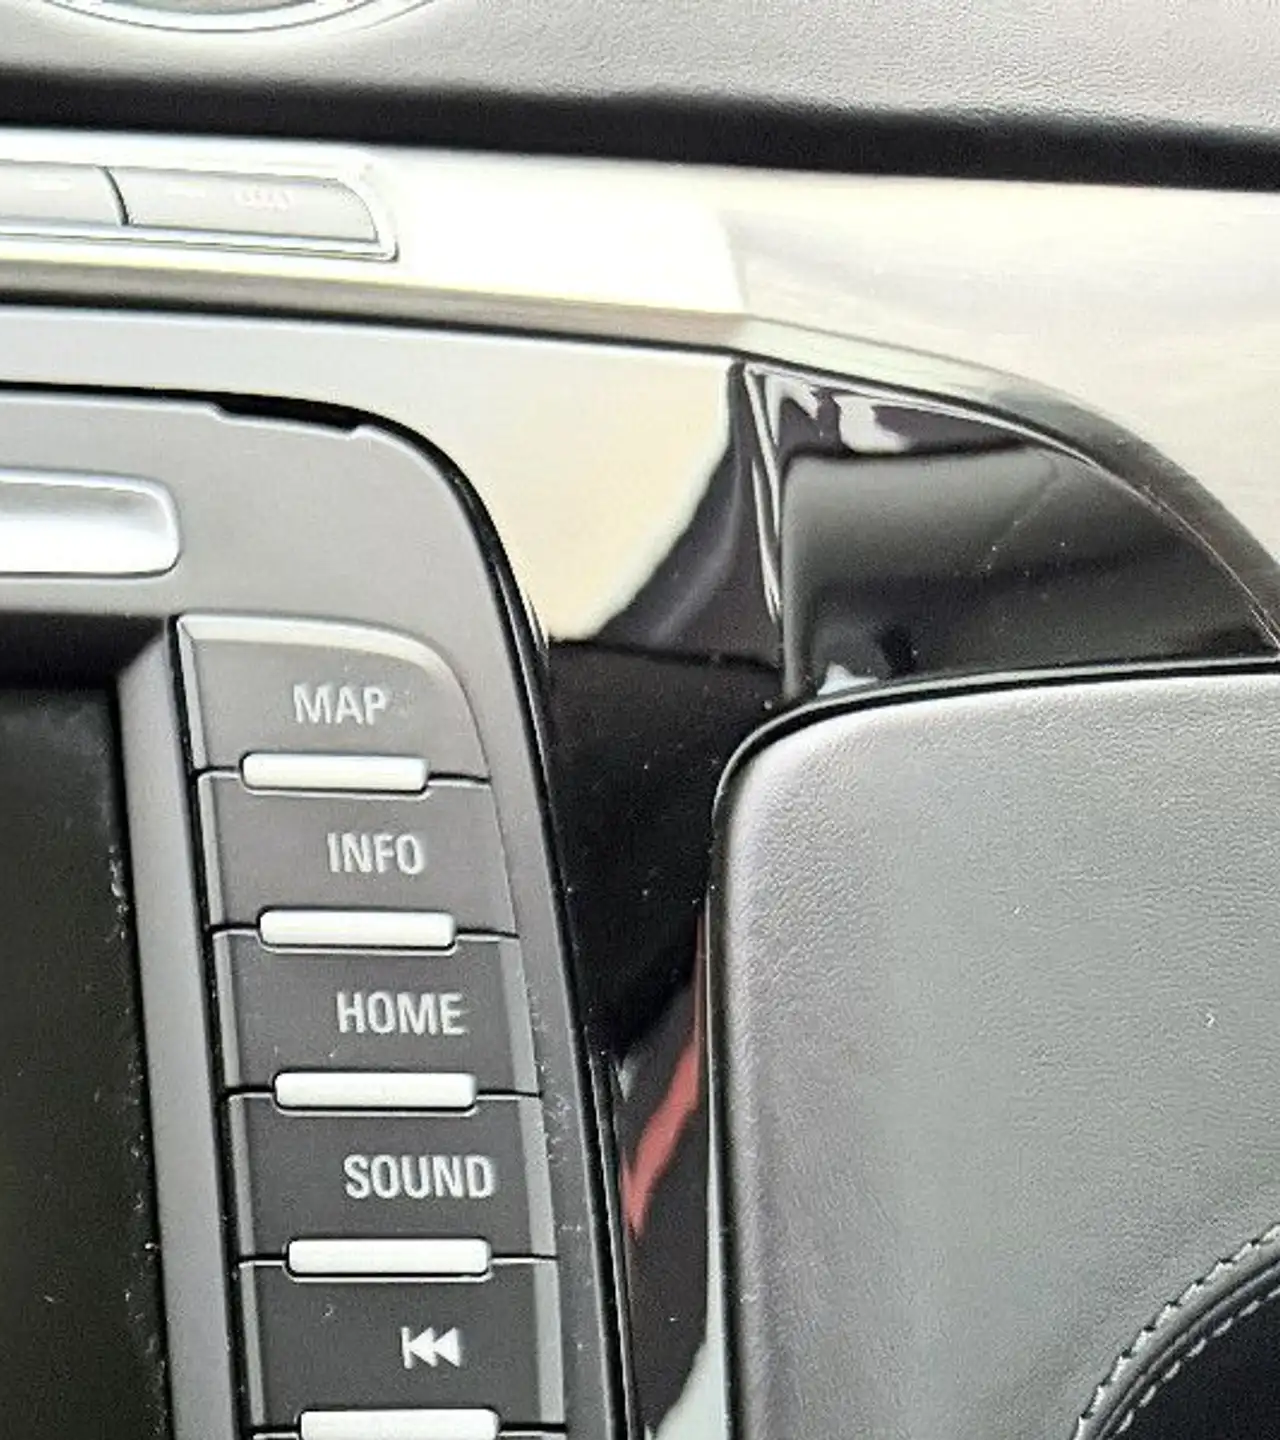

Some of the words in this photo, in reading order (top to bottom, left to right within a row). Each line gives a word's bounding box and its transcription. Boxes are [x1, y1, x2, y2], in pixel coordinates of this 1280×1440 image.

[292, 683, 389, 726] MAP
[326, 832, 426, 876] INFO
[336, 990, 466, 1036] HOME
[343, 1153, 496, 1200] SOUND
